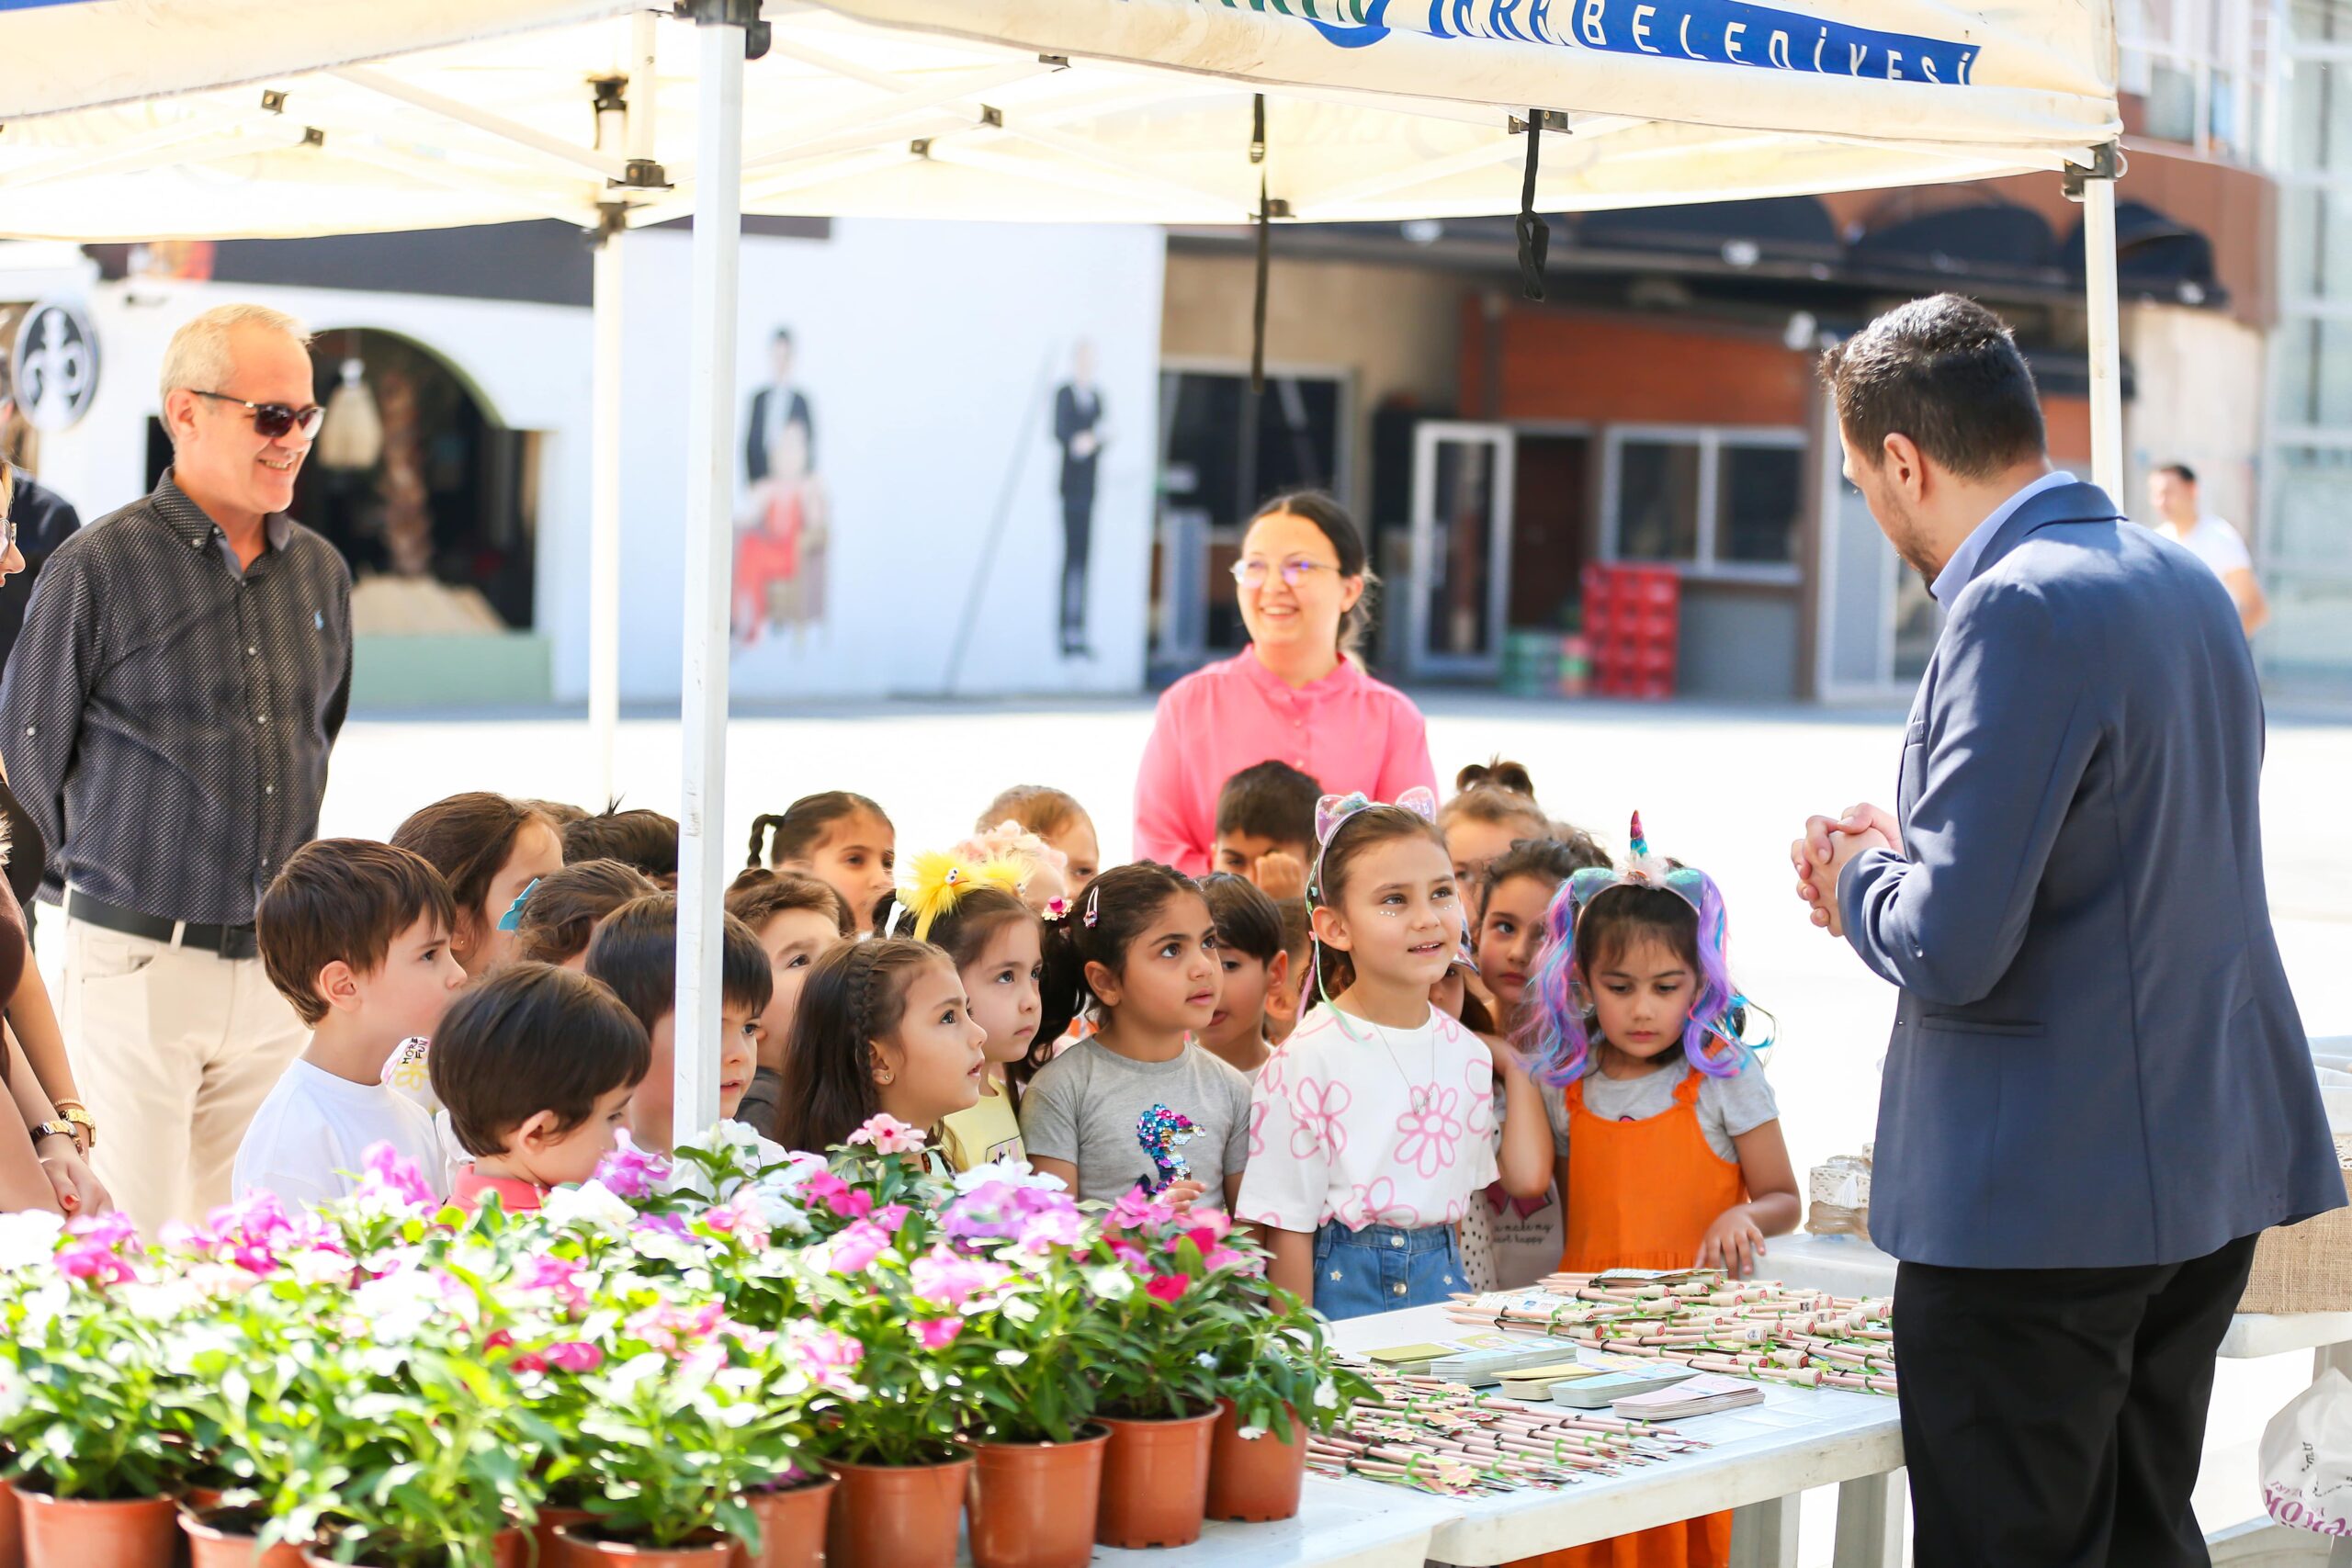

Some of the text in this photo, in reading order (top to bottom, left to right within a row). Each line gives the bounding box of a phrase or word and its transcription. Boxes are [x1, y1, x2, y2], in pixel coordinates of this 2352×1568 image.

[401, 1037, 418, 1064] MORE
[415, 1040, 428, 1058] FUN
[1515, 1235, 1545, 1245] happy
